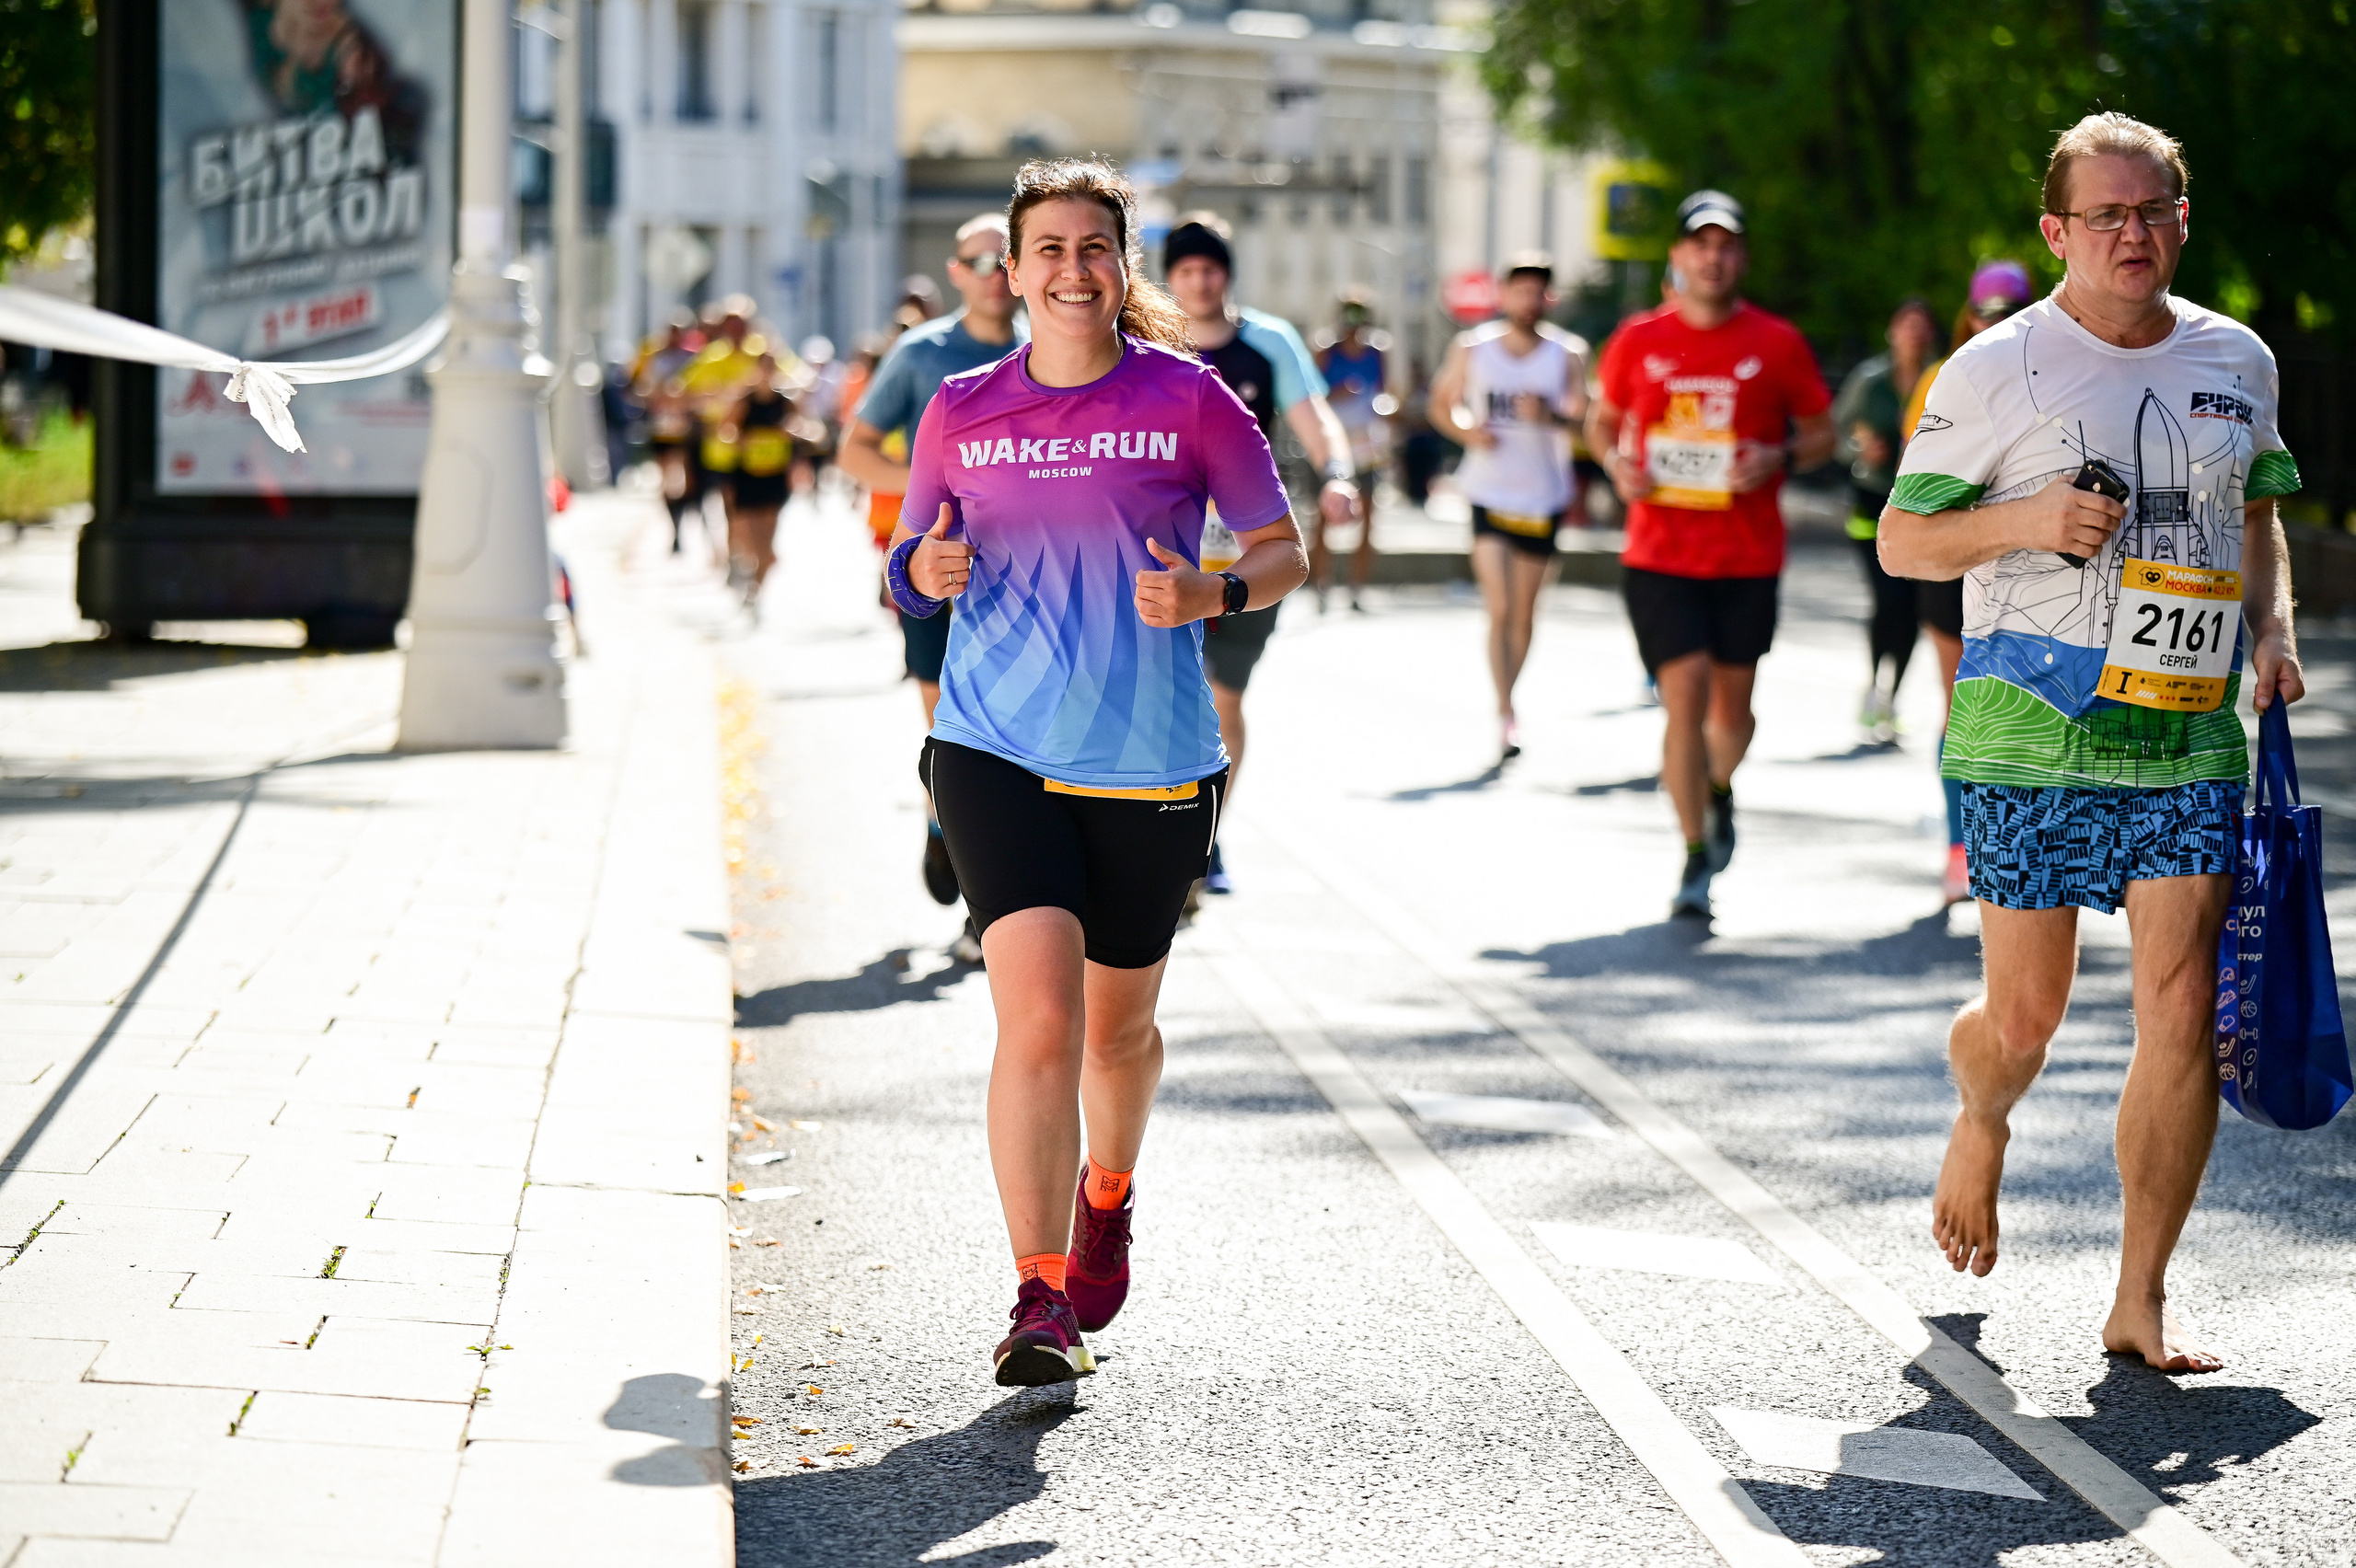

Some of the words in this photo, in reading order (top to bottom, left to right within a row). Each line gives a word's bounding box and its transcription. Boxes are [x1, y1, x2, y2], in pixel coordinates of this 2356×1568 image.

[193, 108, 385, 202] БИТВА
[234, 170, 421, 262] ШКОЛ
[958, 432, 1177, 468] WAKE&RUN
[1028, 467, 1092, 479] MOSCOW
[2165, 580, 2207, 594] МОСКВА
[2166, 570, 2214, 584] МАРАФОН
[2131, 603, 2223, 652] 2161
[2159, 654, 2198, 669] СЕРГЕЙ
